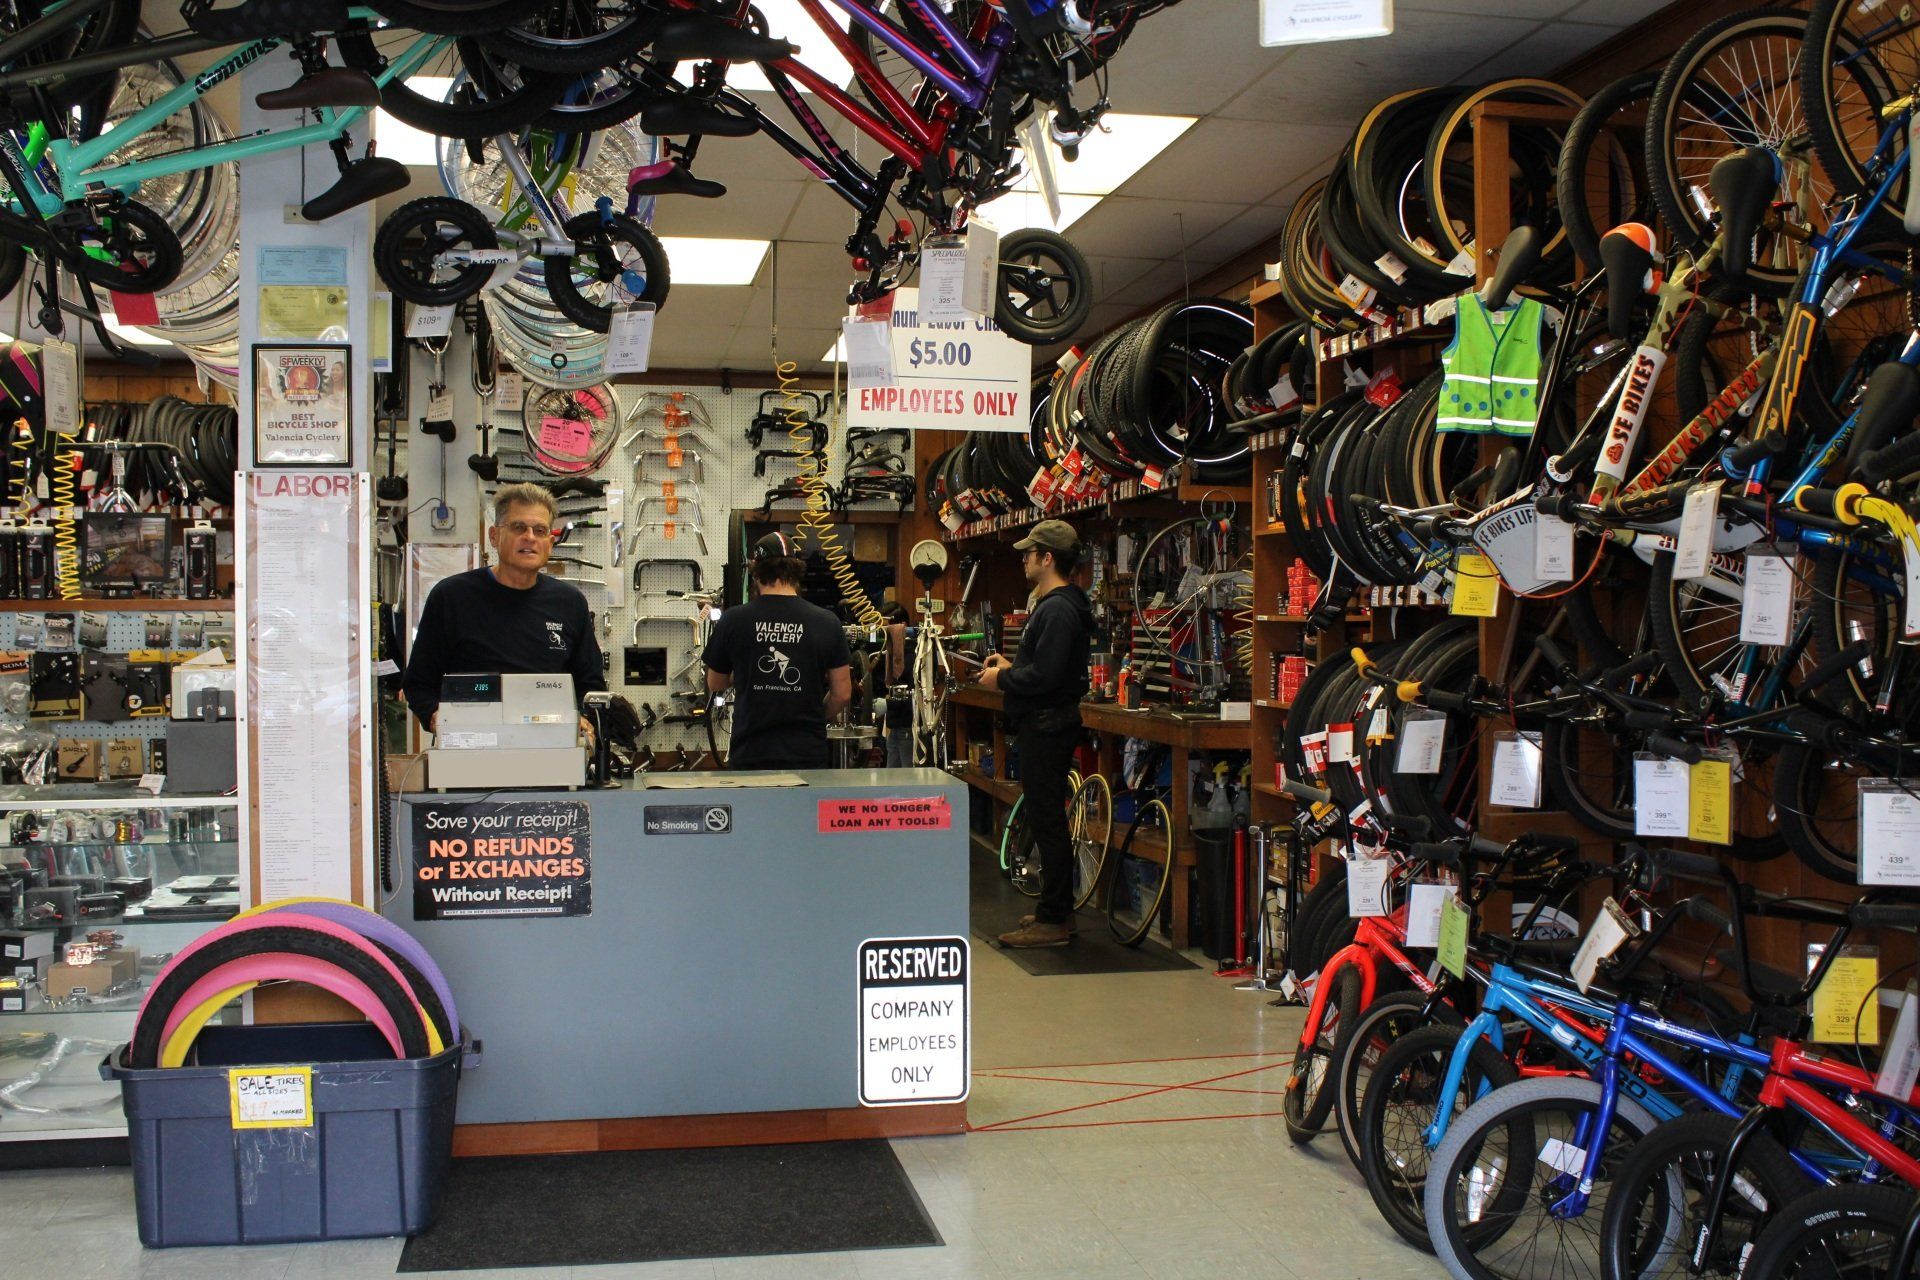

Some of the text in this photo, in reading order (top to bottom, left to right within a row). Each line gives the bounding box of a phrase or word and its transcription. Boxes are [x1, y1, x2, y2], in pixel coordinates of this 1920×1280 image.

[194, 38, 279, 95] Sunday
[783, 87, 840, 157] TREK
[909, 337, 972, 368] $5.00
[860, 388, 1018, 416] EMPLOYEES ONLY
[1613, 354, 1656, 443] SE BIKES
[267, 421, 338, 429] BICYCLE SHOP
[291, 413, 315, 421] BEST
[265, 433, 342, 443] Valencia Cyclery
[256, 475, 350, 498] LABOR
[1489, 515, 1515, 539] BIKES
[755, 621, 804, 633] VALENCIA
[756, 632, 803, 643] CYCLERY
[111, 744, 137, 752] SURLY
[838, 803, 931, 814] WE NO LONGER
[425, 809, 578, 834] Save your receipt!
[647, 820, 698, 831] No Smoking
[830, 817, 939, 828] LOAN ANY TOOLS!
[429, 836, 575, 858] NO REFUNDS
[419, 858, 586, 880] or EXCHANGES
[432, 884, 572, 904] Without Receipt!
[865, 946, 962, 980] RESERVED
[871, 1000, 954, 1020] COMPANY
[869, 1034, 957, 1053] EMPLOYEES
[239, 1075, 305, 1091] SALE TIRES
[891, 1065, 934, 1084] ONLY
